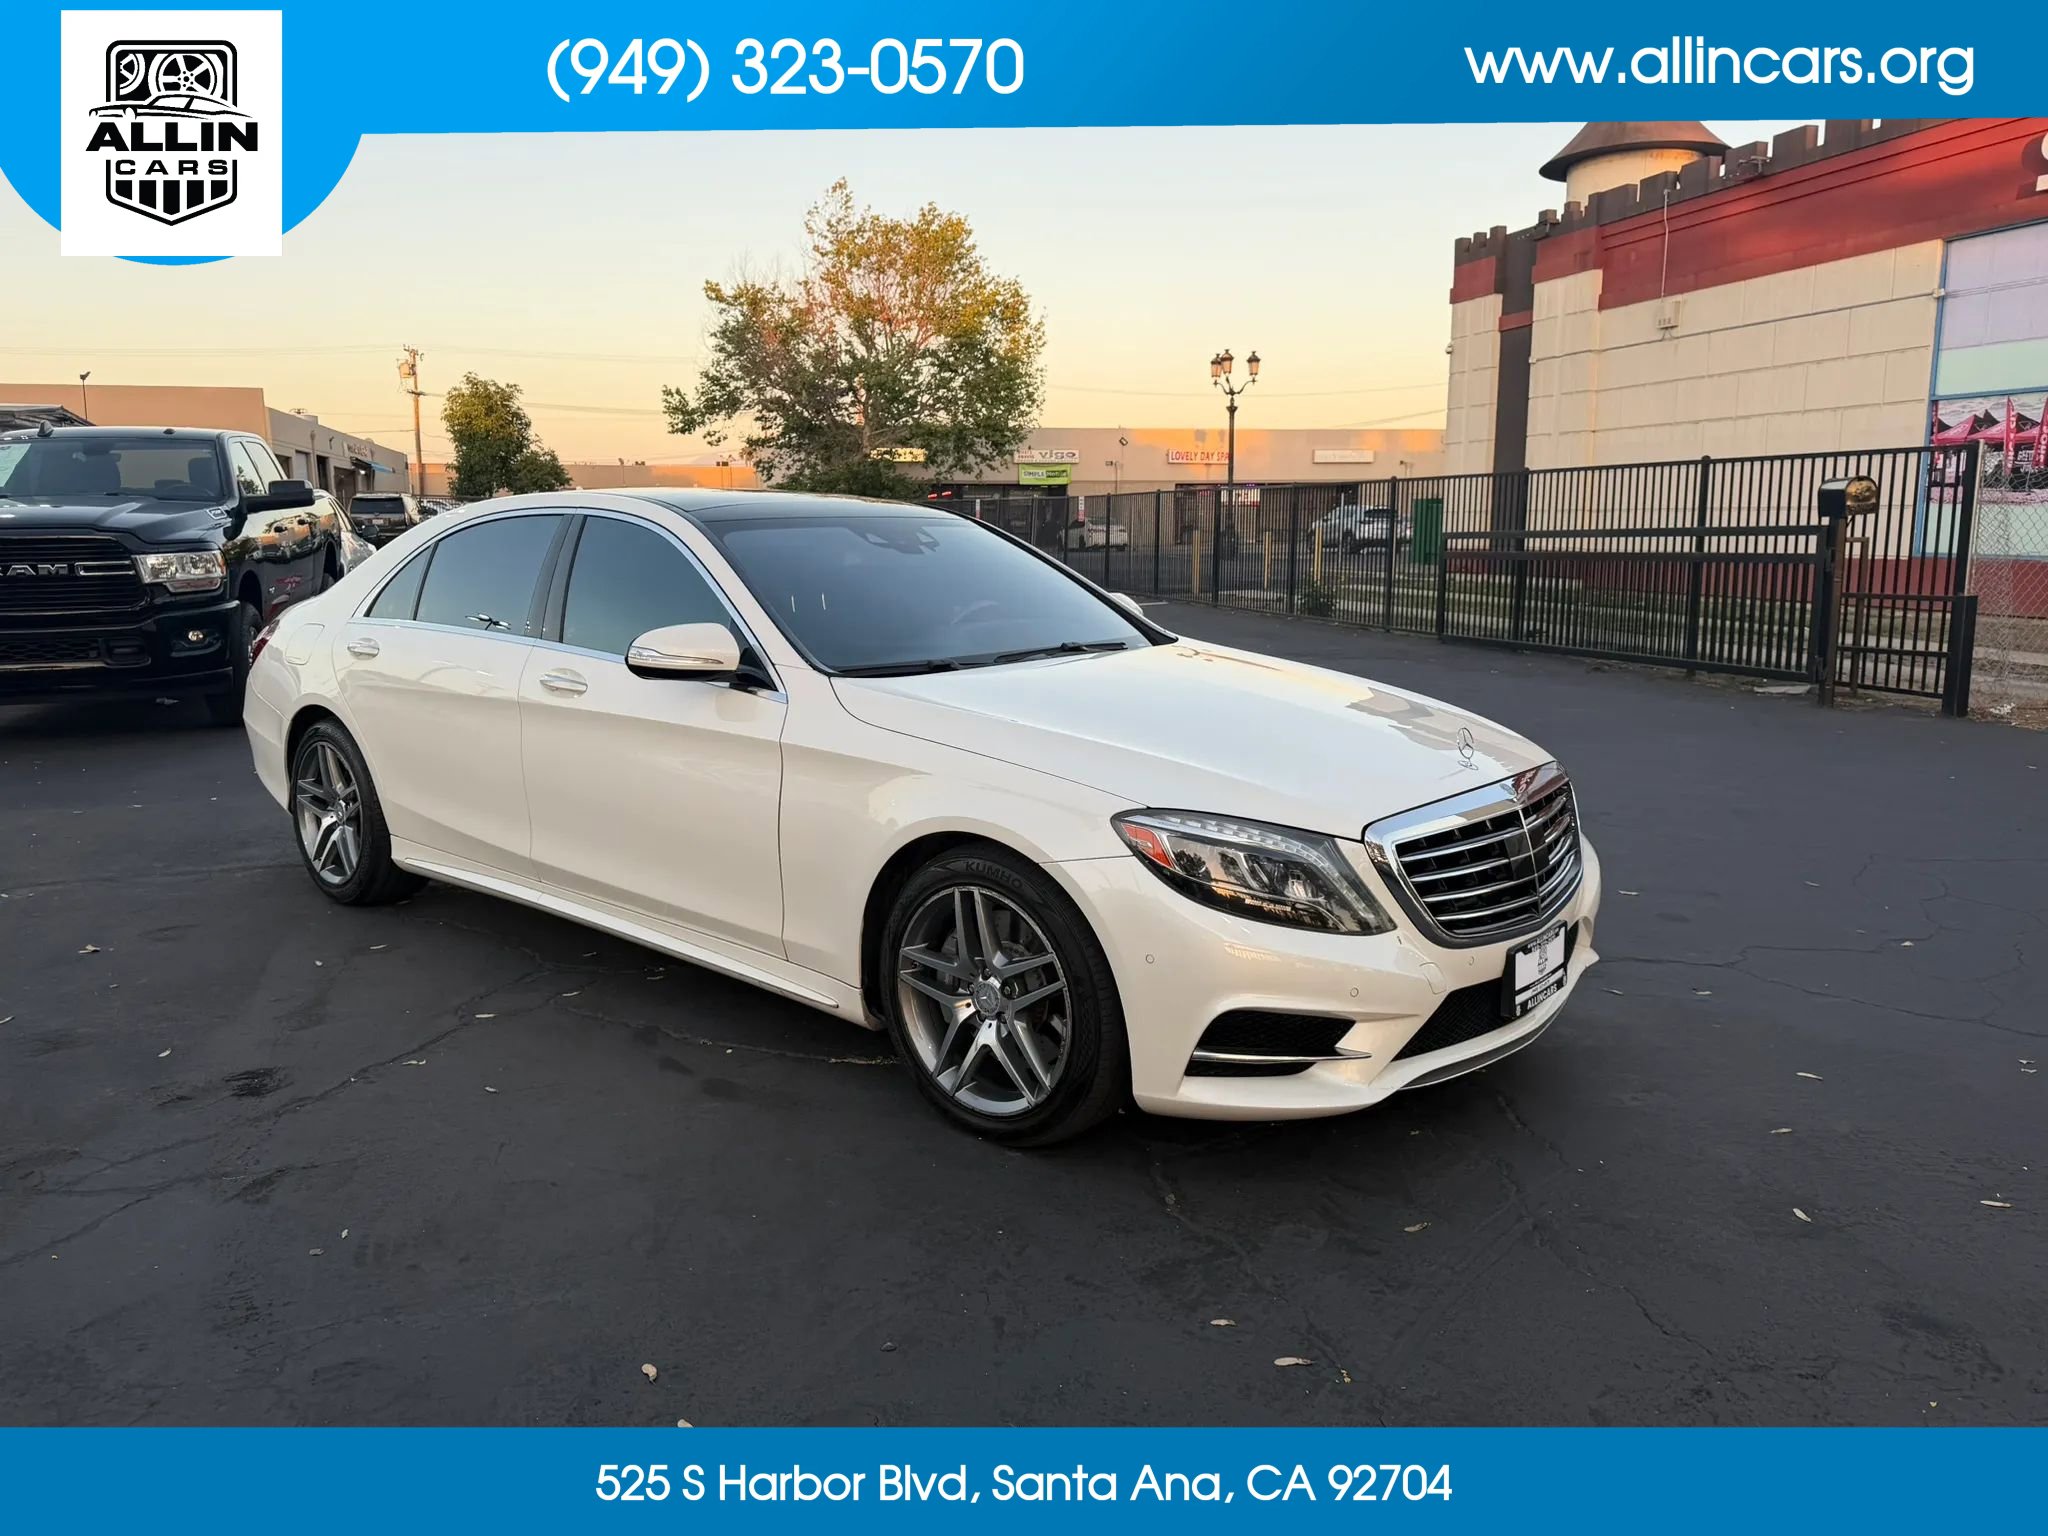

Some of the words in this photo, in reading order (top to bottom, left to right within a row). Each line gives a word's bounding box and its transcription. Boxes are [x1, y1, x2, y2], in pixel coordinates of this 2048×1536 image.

[1171, 451, 1198, 461] LOVELY
[1200, 452, 1215, 461] DAY
[0, 564, 68, 576] AM
[964, 861, 1023, 889] KUMHO
